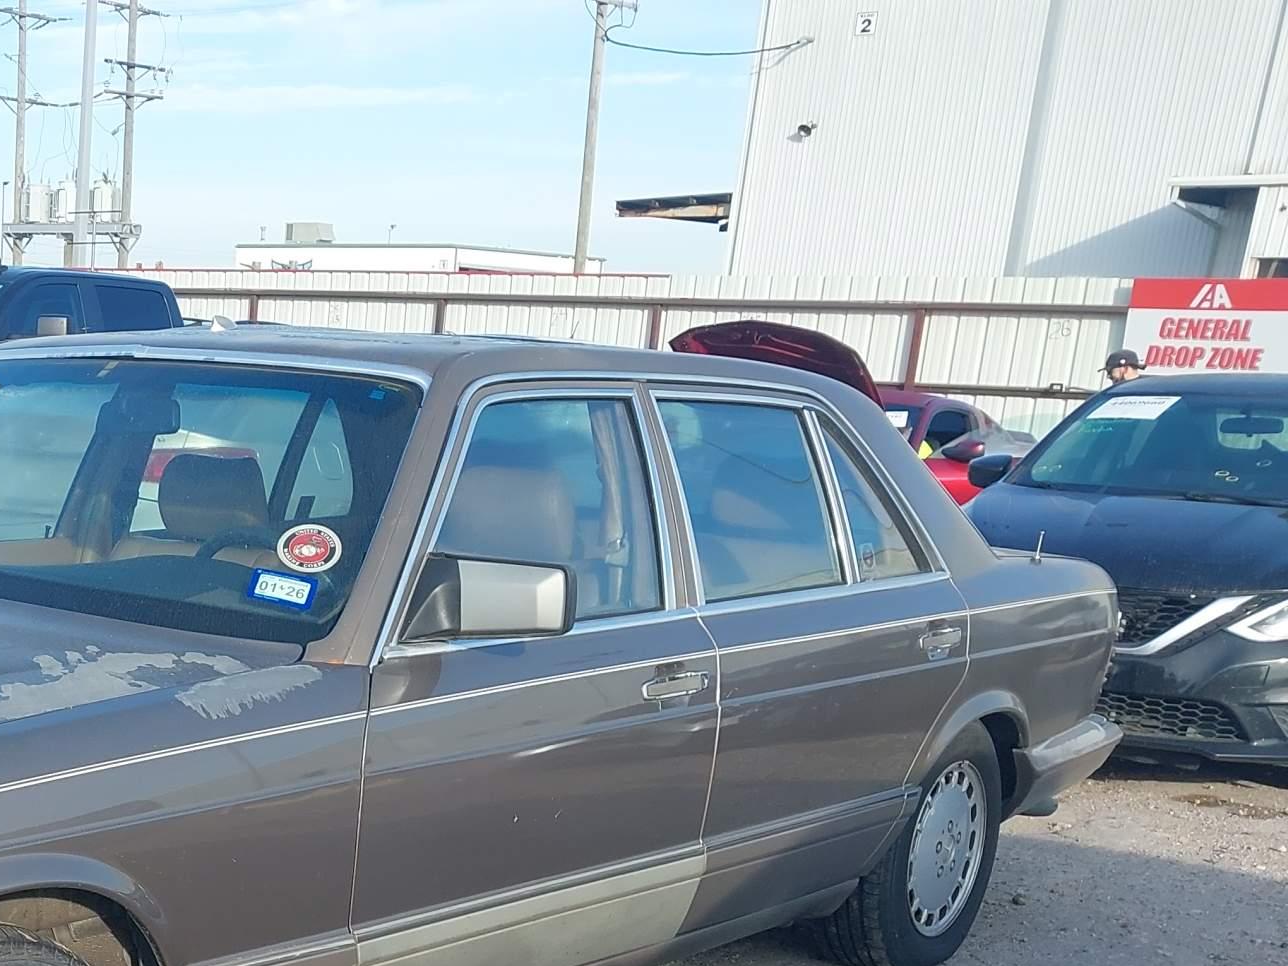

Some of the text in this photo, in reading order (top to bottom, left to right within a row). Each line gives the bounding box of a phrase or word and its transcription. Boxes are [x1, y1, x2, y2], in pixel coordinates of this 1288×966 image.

[861, 18, 872, 33] 2
[1158, 317, 1254, 341] GENERAL
[1144, 345, 1264, 371] DROP ZONE
